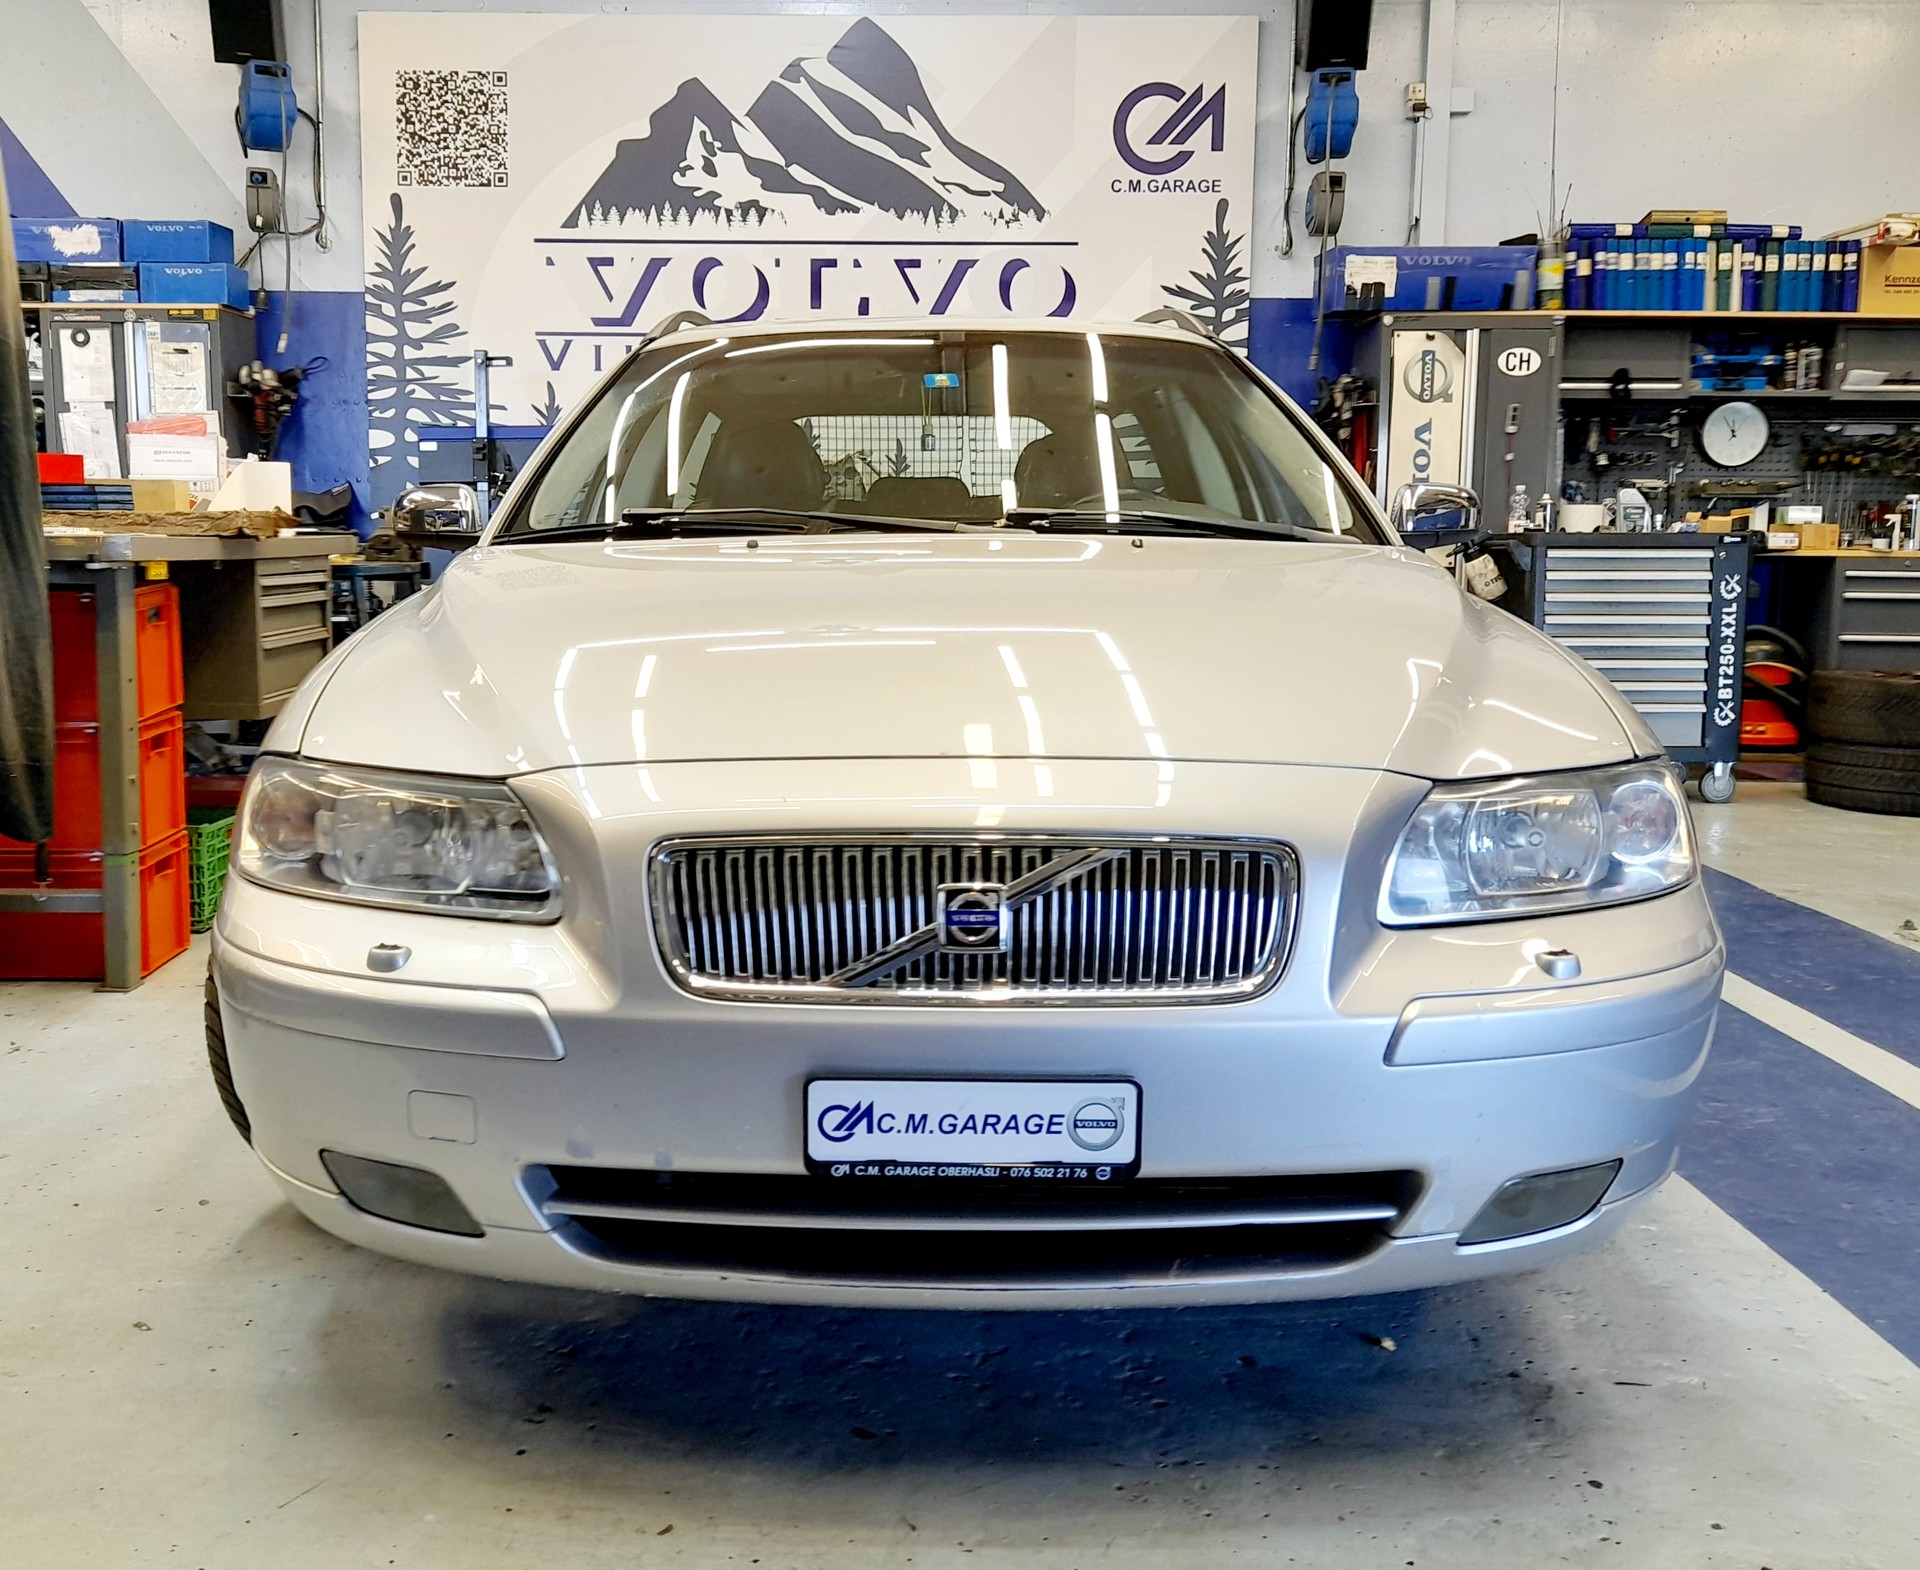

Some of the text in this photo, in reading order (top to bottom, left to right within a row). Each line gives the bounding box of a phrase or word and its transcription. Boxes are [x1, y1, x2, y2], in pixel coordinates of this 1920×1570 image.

[1111, 178, 1222, 193] C.M.GARAGE
[164, 267, 203, 276] VOLVO
[1504, 352, 1531, 373] CH
[1421, 352, 1434, 400] VOLVO
[1717, 602, 1738, 700] BT250-XXL
[877, 1113, 1065, 1135] C.M.GARAGE
[1075, 1120, 1116, 1128] VOLVO
[854, 1165, 881, 1175] C.M.
[884, 1166, 936, 1176] GARAGE
[1010, 1167, 1031, 1177] 076
[1033, 1168, 1055, 1177] 502
[1056, 1168, 1070, 1177] 21
[1073, 1168, 1088, 1178] 76
